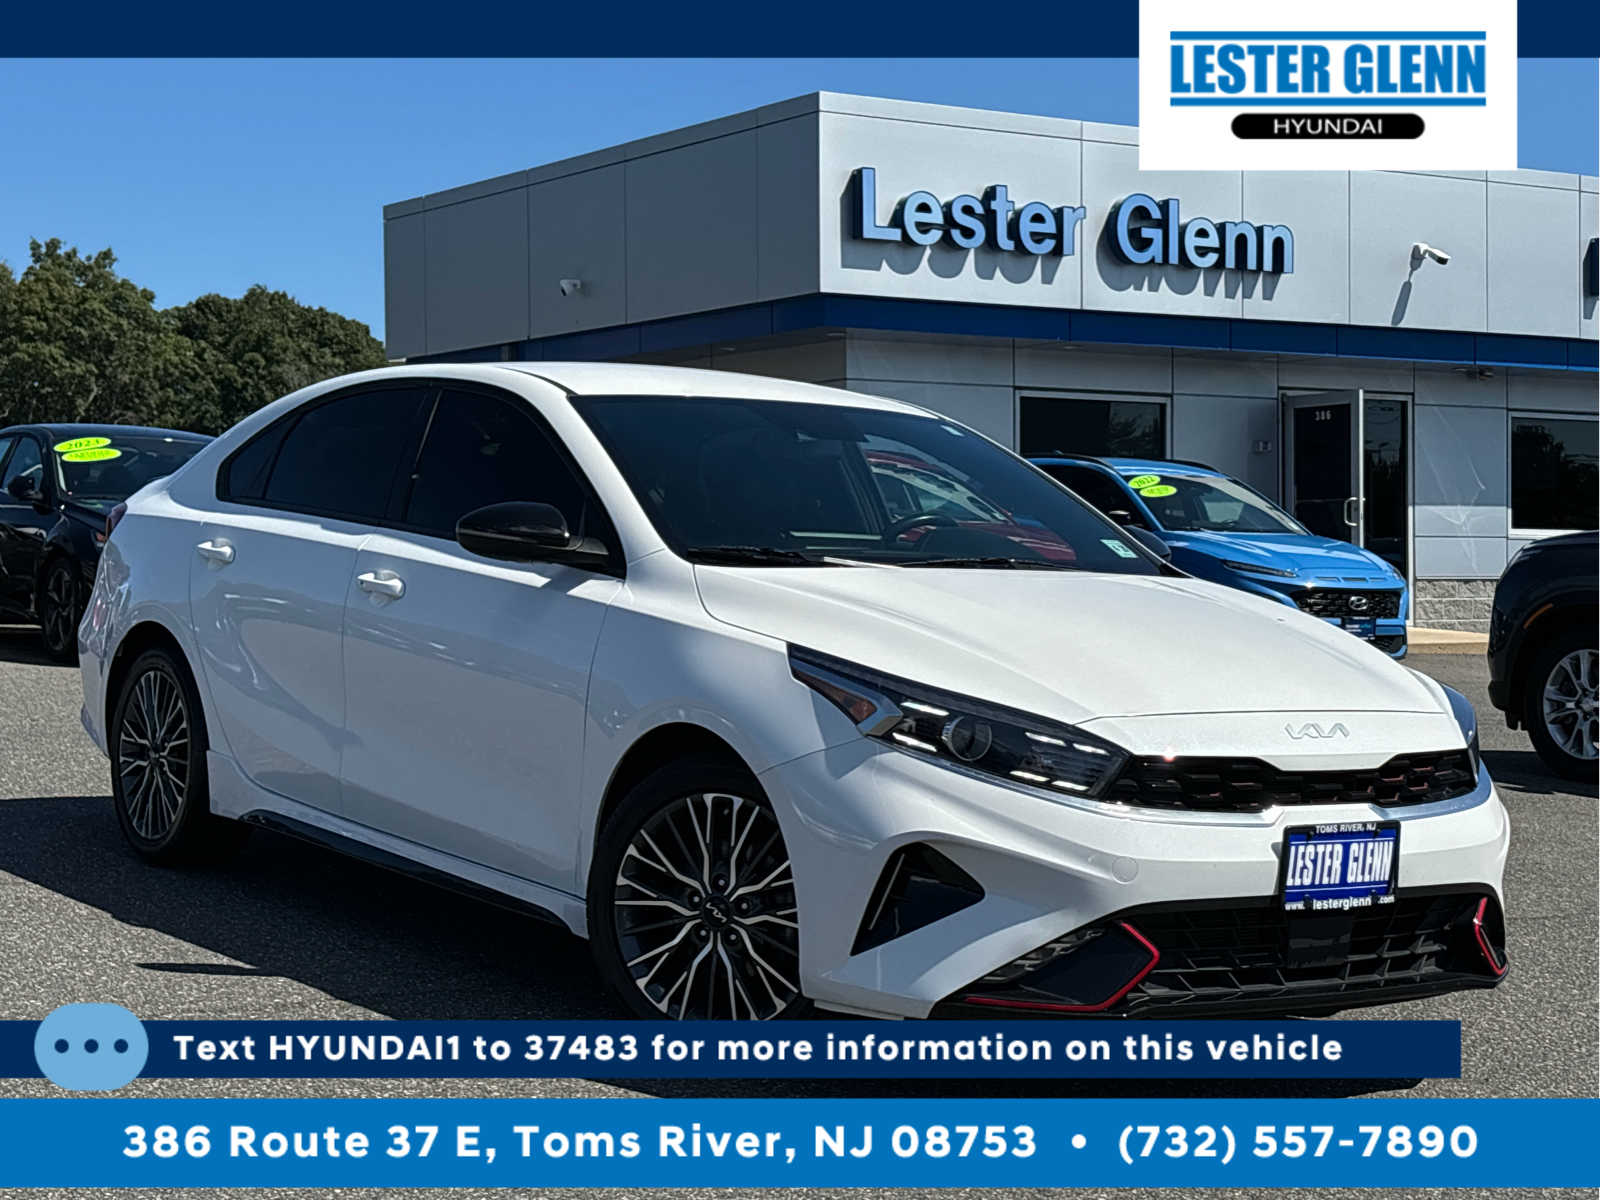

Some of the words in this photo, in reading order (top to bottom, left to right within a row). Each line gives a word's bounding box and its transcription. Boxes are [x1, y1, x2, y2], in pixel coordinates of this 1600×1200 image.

[855, 167, 1086, 257] Lester
[1112, 193, 1295, 275] Glenn
[1315, 825, 1337, 834] TOMS
[1366, 822, 1376, 831] NJ
[1286, 843, 1343, 886] LESTER
[1347, 841, 1394, 883] GLENN
[1313, 896, 1372, 910] lesterglenn
